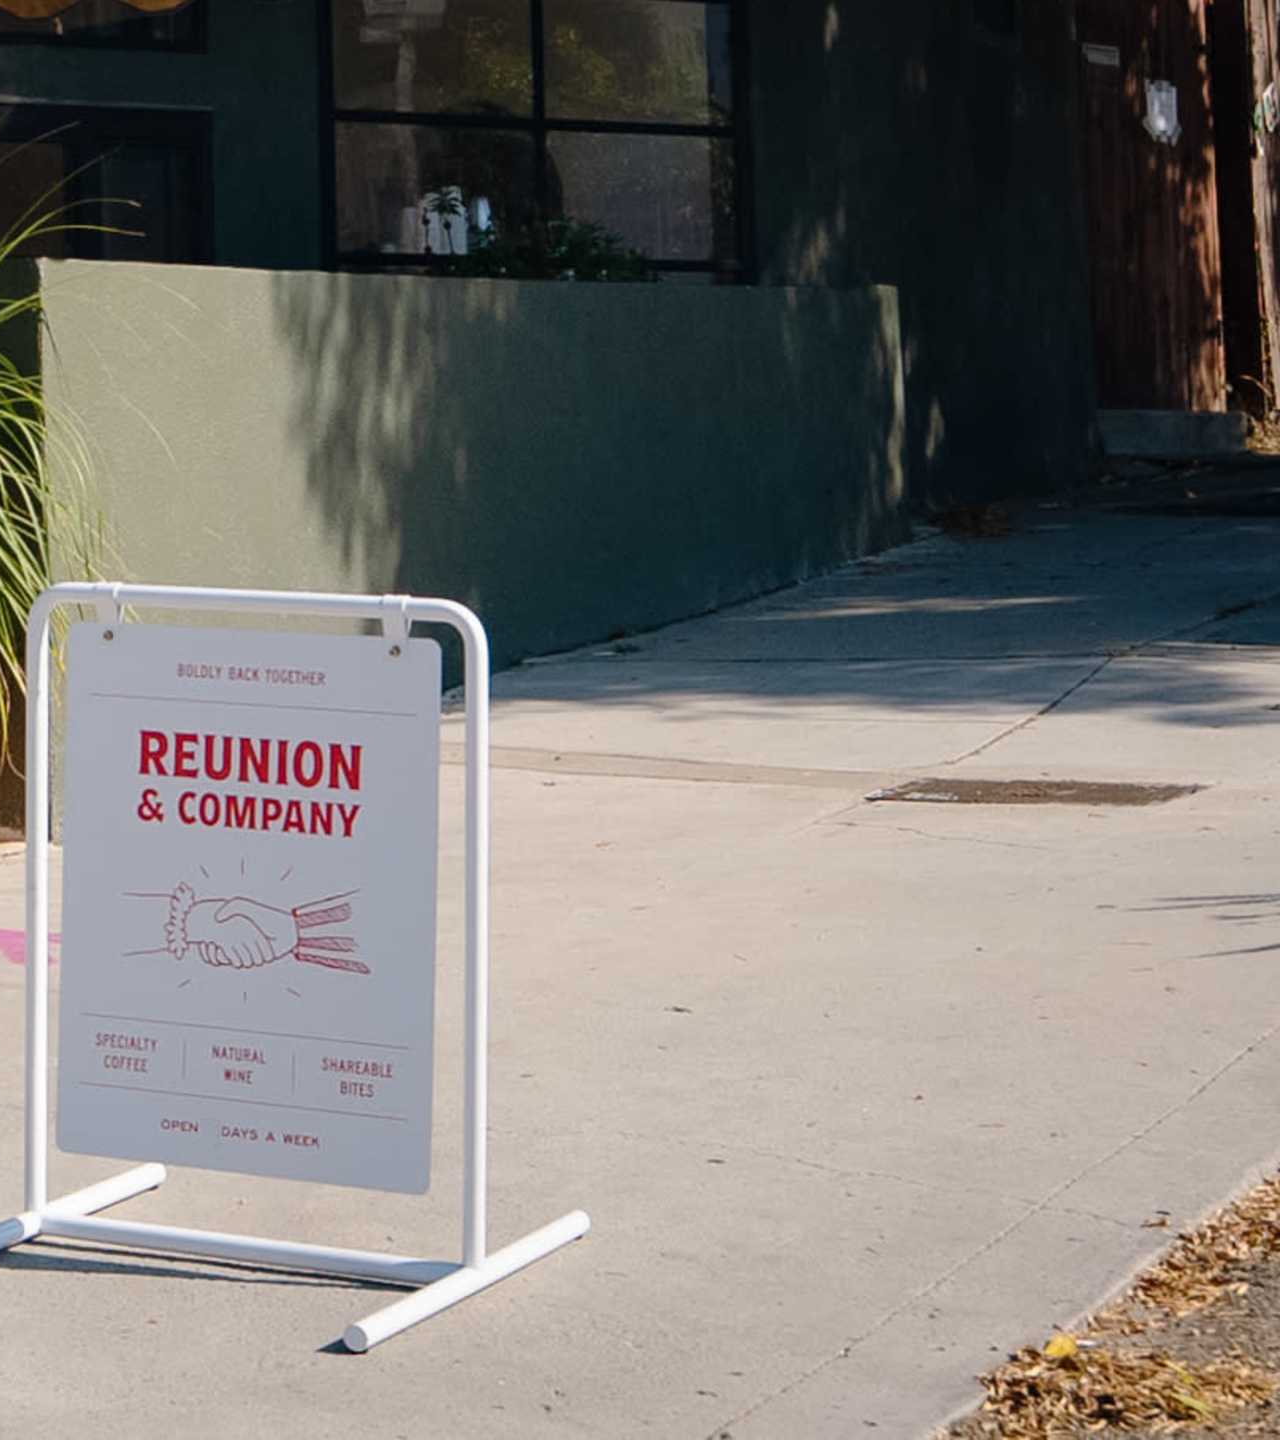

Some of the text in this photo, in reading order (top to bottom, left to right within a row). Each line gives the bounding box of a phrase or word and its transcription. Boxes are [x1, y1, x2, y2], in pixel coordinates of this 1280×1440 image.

[176, 662, 327, 686] BOLDLY BACK TOGETHER
[138, 729, 363, 791] REUNION
[137, 788, 361, 838] & COMPANY
[95, 1032, 159, 1052] SPECIALTY
[103, 1055, 148, 1073] COFFEE
[211, 1045, 266, 1064] NATURAL
[223, 1069, 254, 1085] WINE
[320, 1057, 393, 1079] SHAREABLE
[339, 1080, 375, 1099] BITES
[160, 1118, 320, 1148] OPEN DAYS A WEEK
